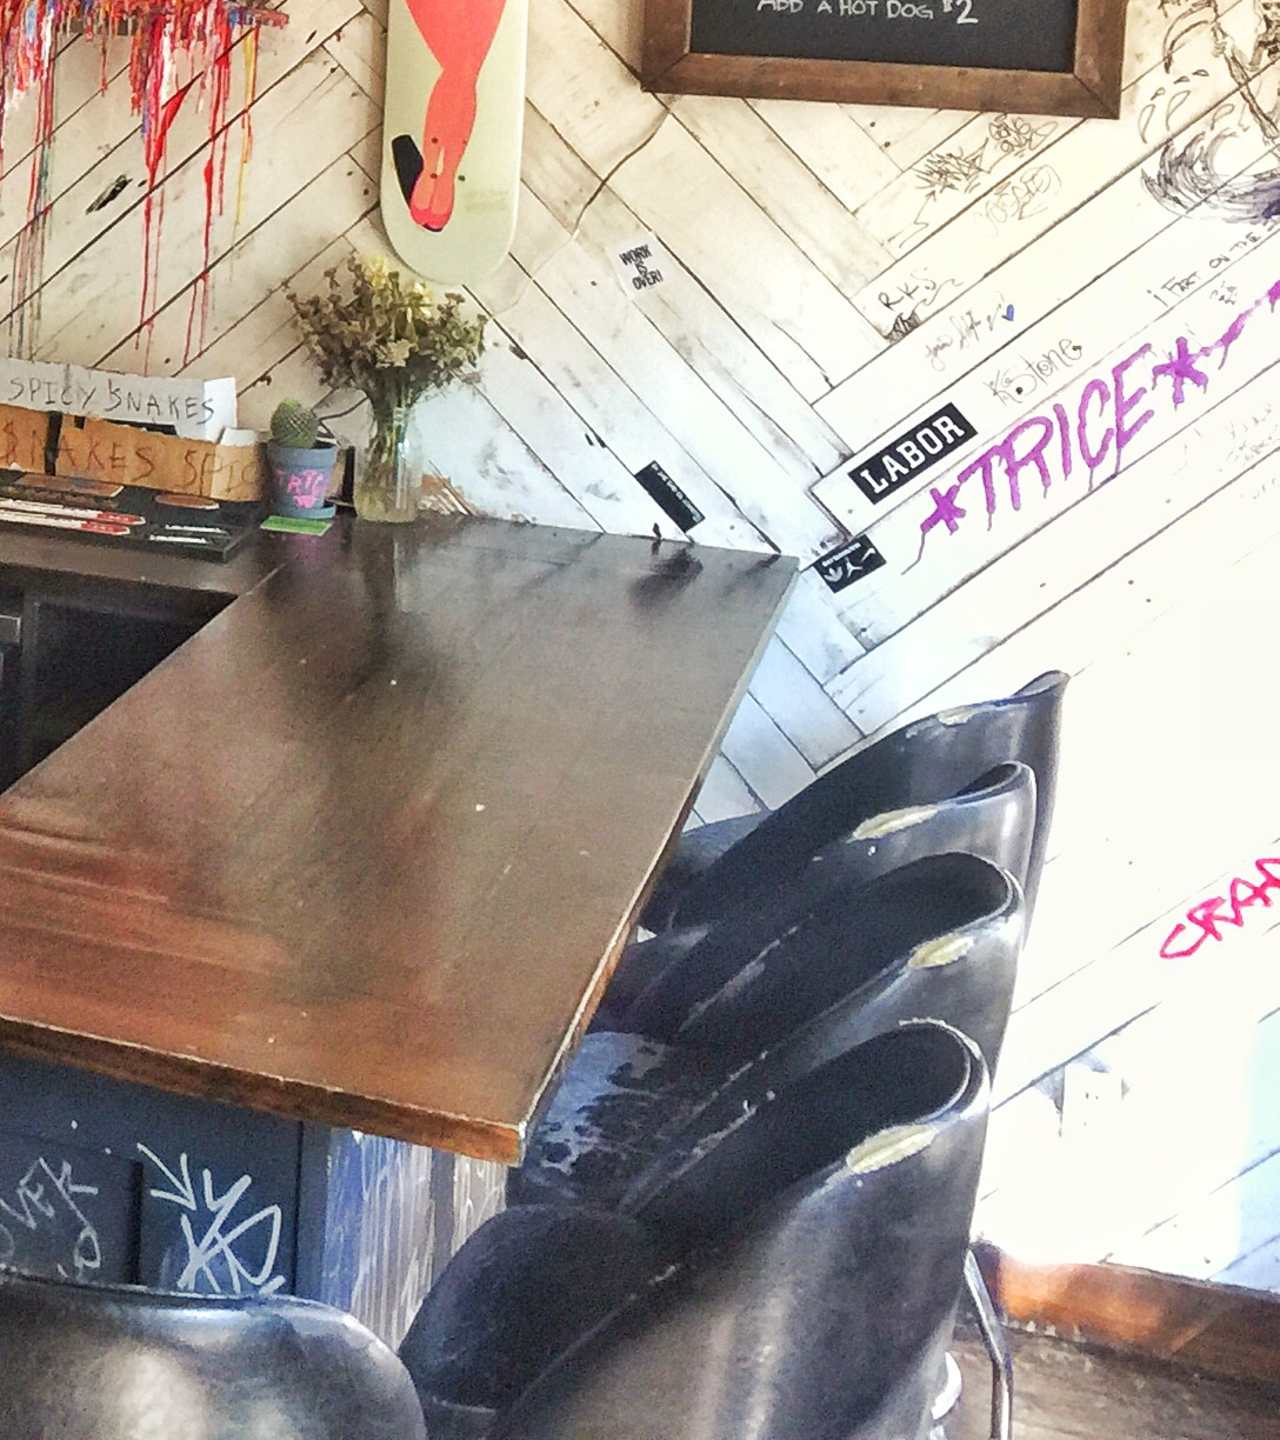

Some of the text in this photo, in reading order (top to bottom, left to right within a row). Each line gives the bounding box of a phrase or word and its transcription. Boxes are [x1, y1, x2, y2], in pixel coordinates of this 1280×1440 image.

[9, 377, 96, 410] SPICY
[105, 378, 216, 424] SNAKES
[860, 415, 966, 494] LABOR
